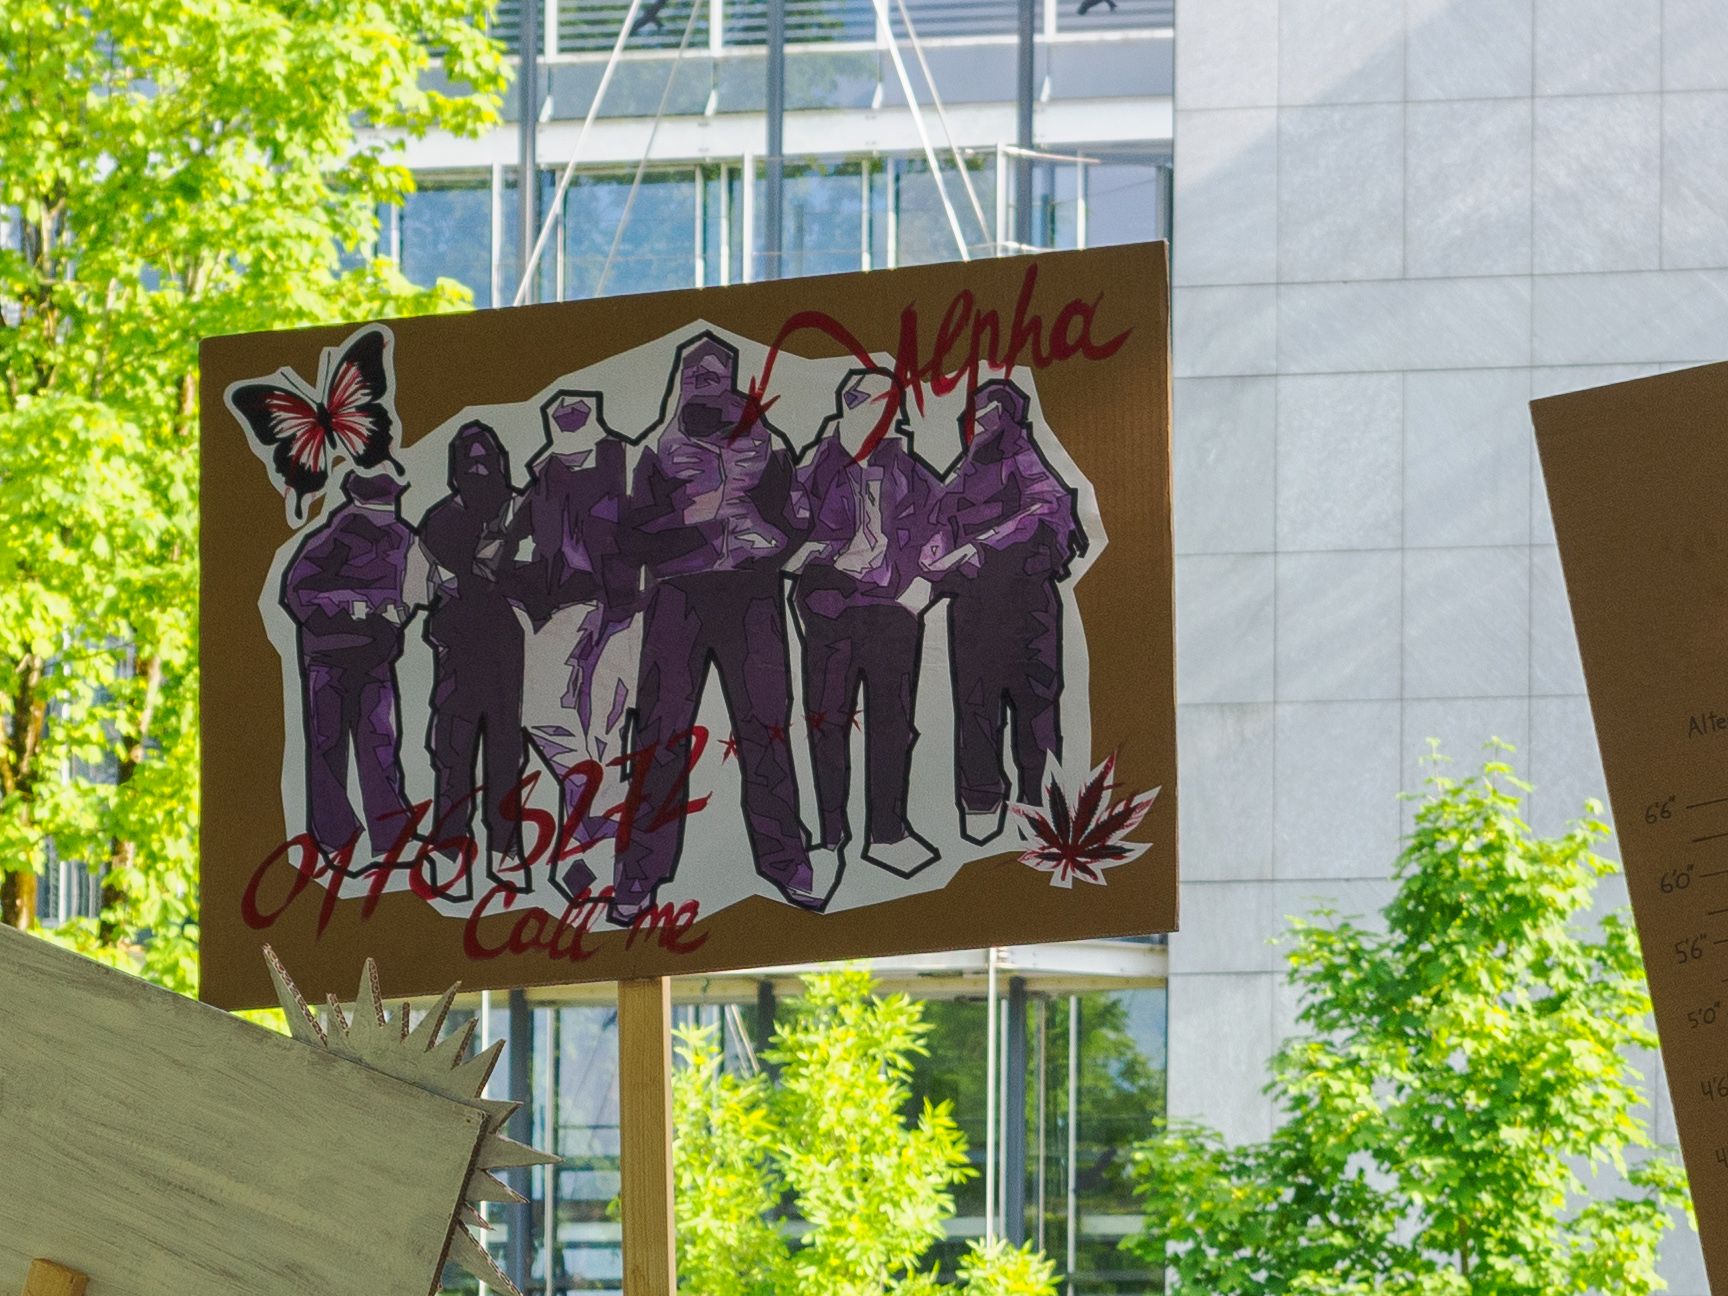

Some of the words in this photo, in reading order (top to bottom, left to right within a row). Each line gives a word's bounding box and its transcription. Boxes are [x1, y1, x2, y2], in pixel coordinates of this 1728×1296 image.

[847, 263, 1135, 466] Alpha
[464, 880, 618, 960] Call
[625, 898, 710, 955] me
